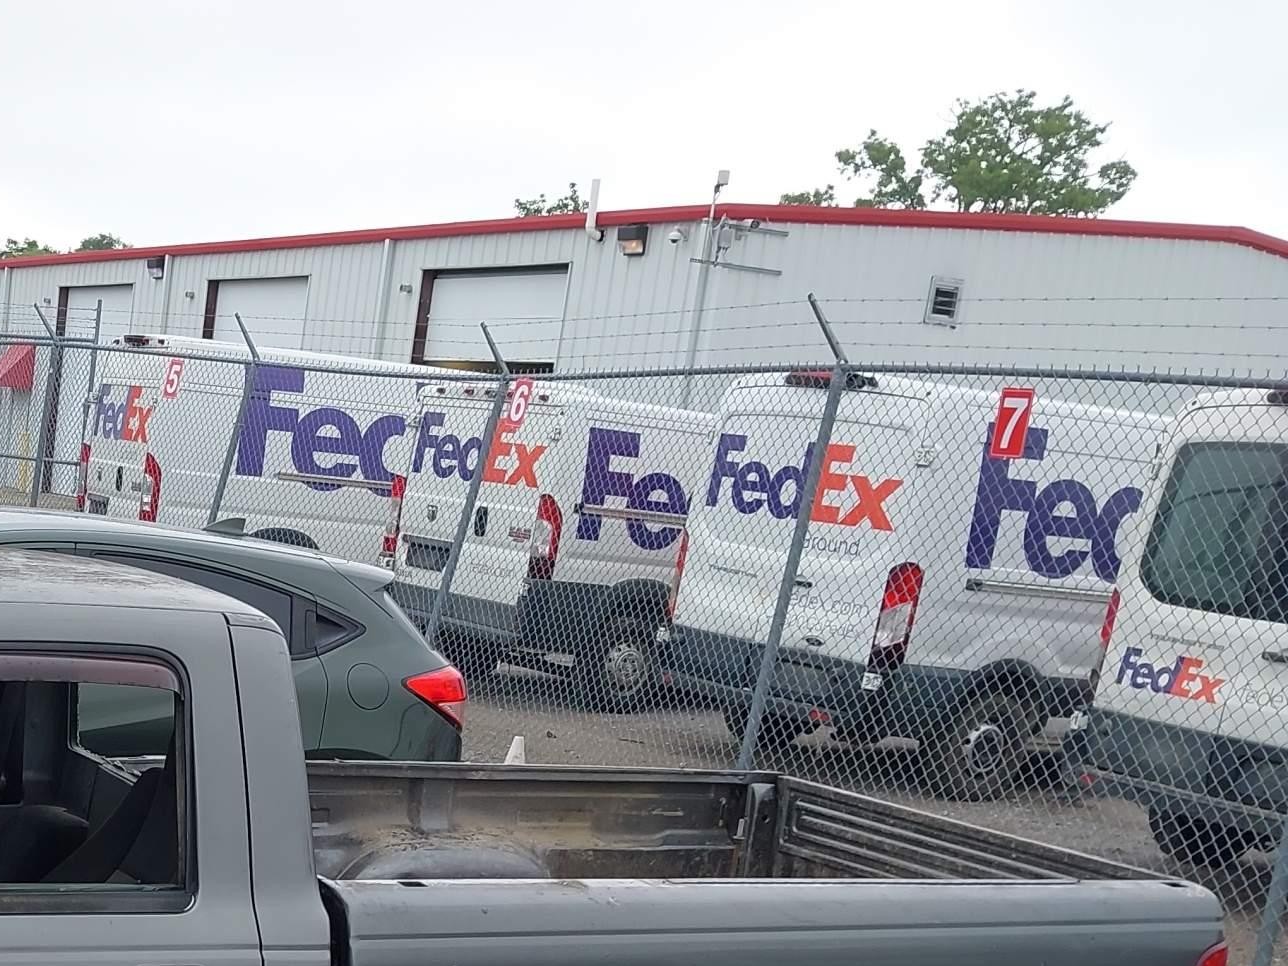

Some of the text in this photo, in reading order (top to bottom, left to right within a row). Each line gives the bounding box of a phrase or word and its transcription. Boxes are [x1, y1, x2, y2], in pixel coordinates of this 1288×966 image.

[166, 364, 180, 394] 5
[510, 384, 529, 421] 6
[94, 383, 153, 443] FedEx
[999, 397, 1030, 449] 7
[706, 432, 904, 532] FedEx
[1116, 647, 1225, 704] FedEx
